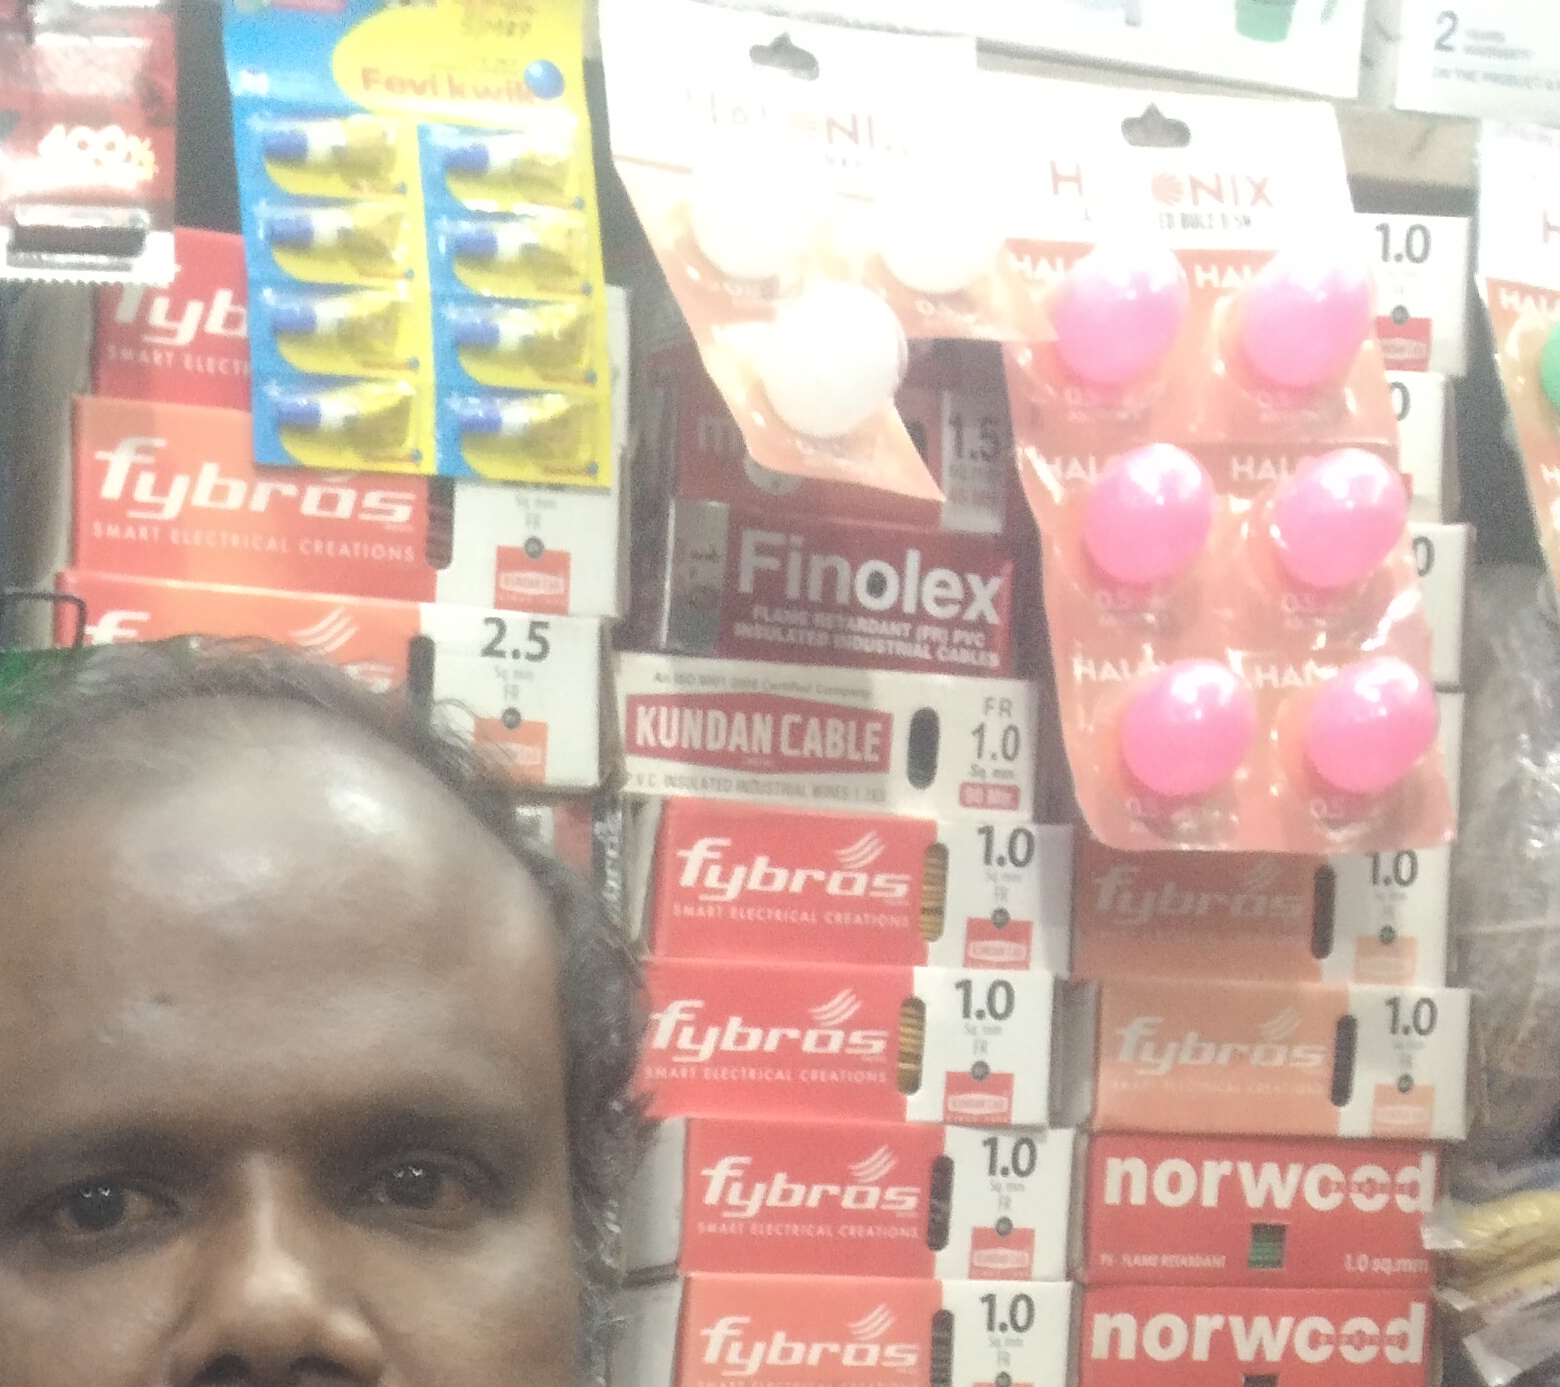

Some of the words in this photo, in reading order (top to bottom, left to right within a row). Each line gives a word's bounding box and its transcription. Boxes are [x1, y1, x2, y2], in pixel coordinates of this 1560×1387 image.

[1374, 222, 1432, 264] 1.0
[107, 268, 252, 346] fyb
[93, 435, 416, 524] fybros
[91, 520, 161, 546] SMART
[170, 525, 289, 556] ELECTRICAL
[298, 537, 416, 565] CREATIONS
[737, 527, 1007, 626] Finolex
[480, 615, 552, 663] 2.5
[814, 610, 912, 640] RETARDANT
[834, 632, 933, 661] INDUSTRIAL
[636, 702, 775, 755] KUNDAN
[779, 712, 884, 763] CABLE
[970, 723, 1021, 763] 1.0
[676, 836, 913, 902] fybros
[976, 824, 1036, 869] 1.0
[1368, 849, 1419, 888] 1.0
[954, 978, 1016, 1022] 1.0
[1384, 996, 1438, 1037] 1.0
[651, 998, 889, 1064] fybros
[1115, 1015, 1327, 1077] fybros
[981, 1136, 1038, 1179] 1.0
[700, 1155, 921, 1219] fybros
[979, 1292, 1036, 1335] 1.0
[699, 1314, 921, 1377] fybros
